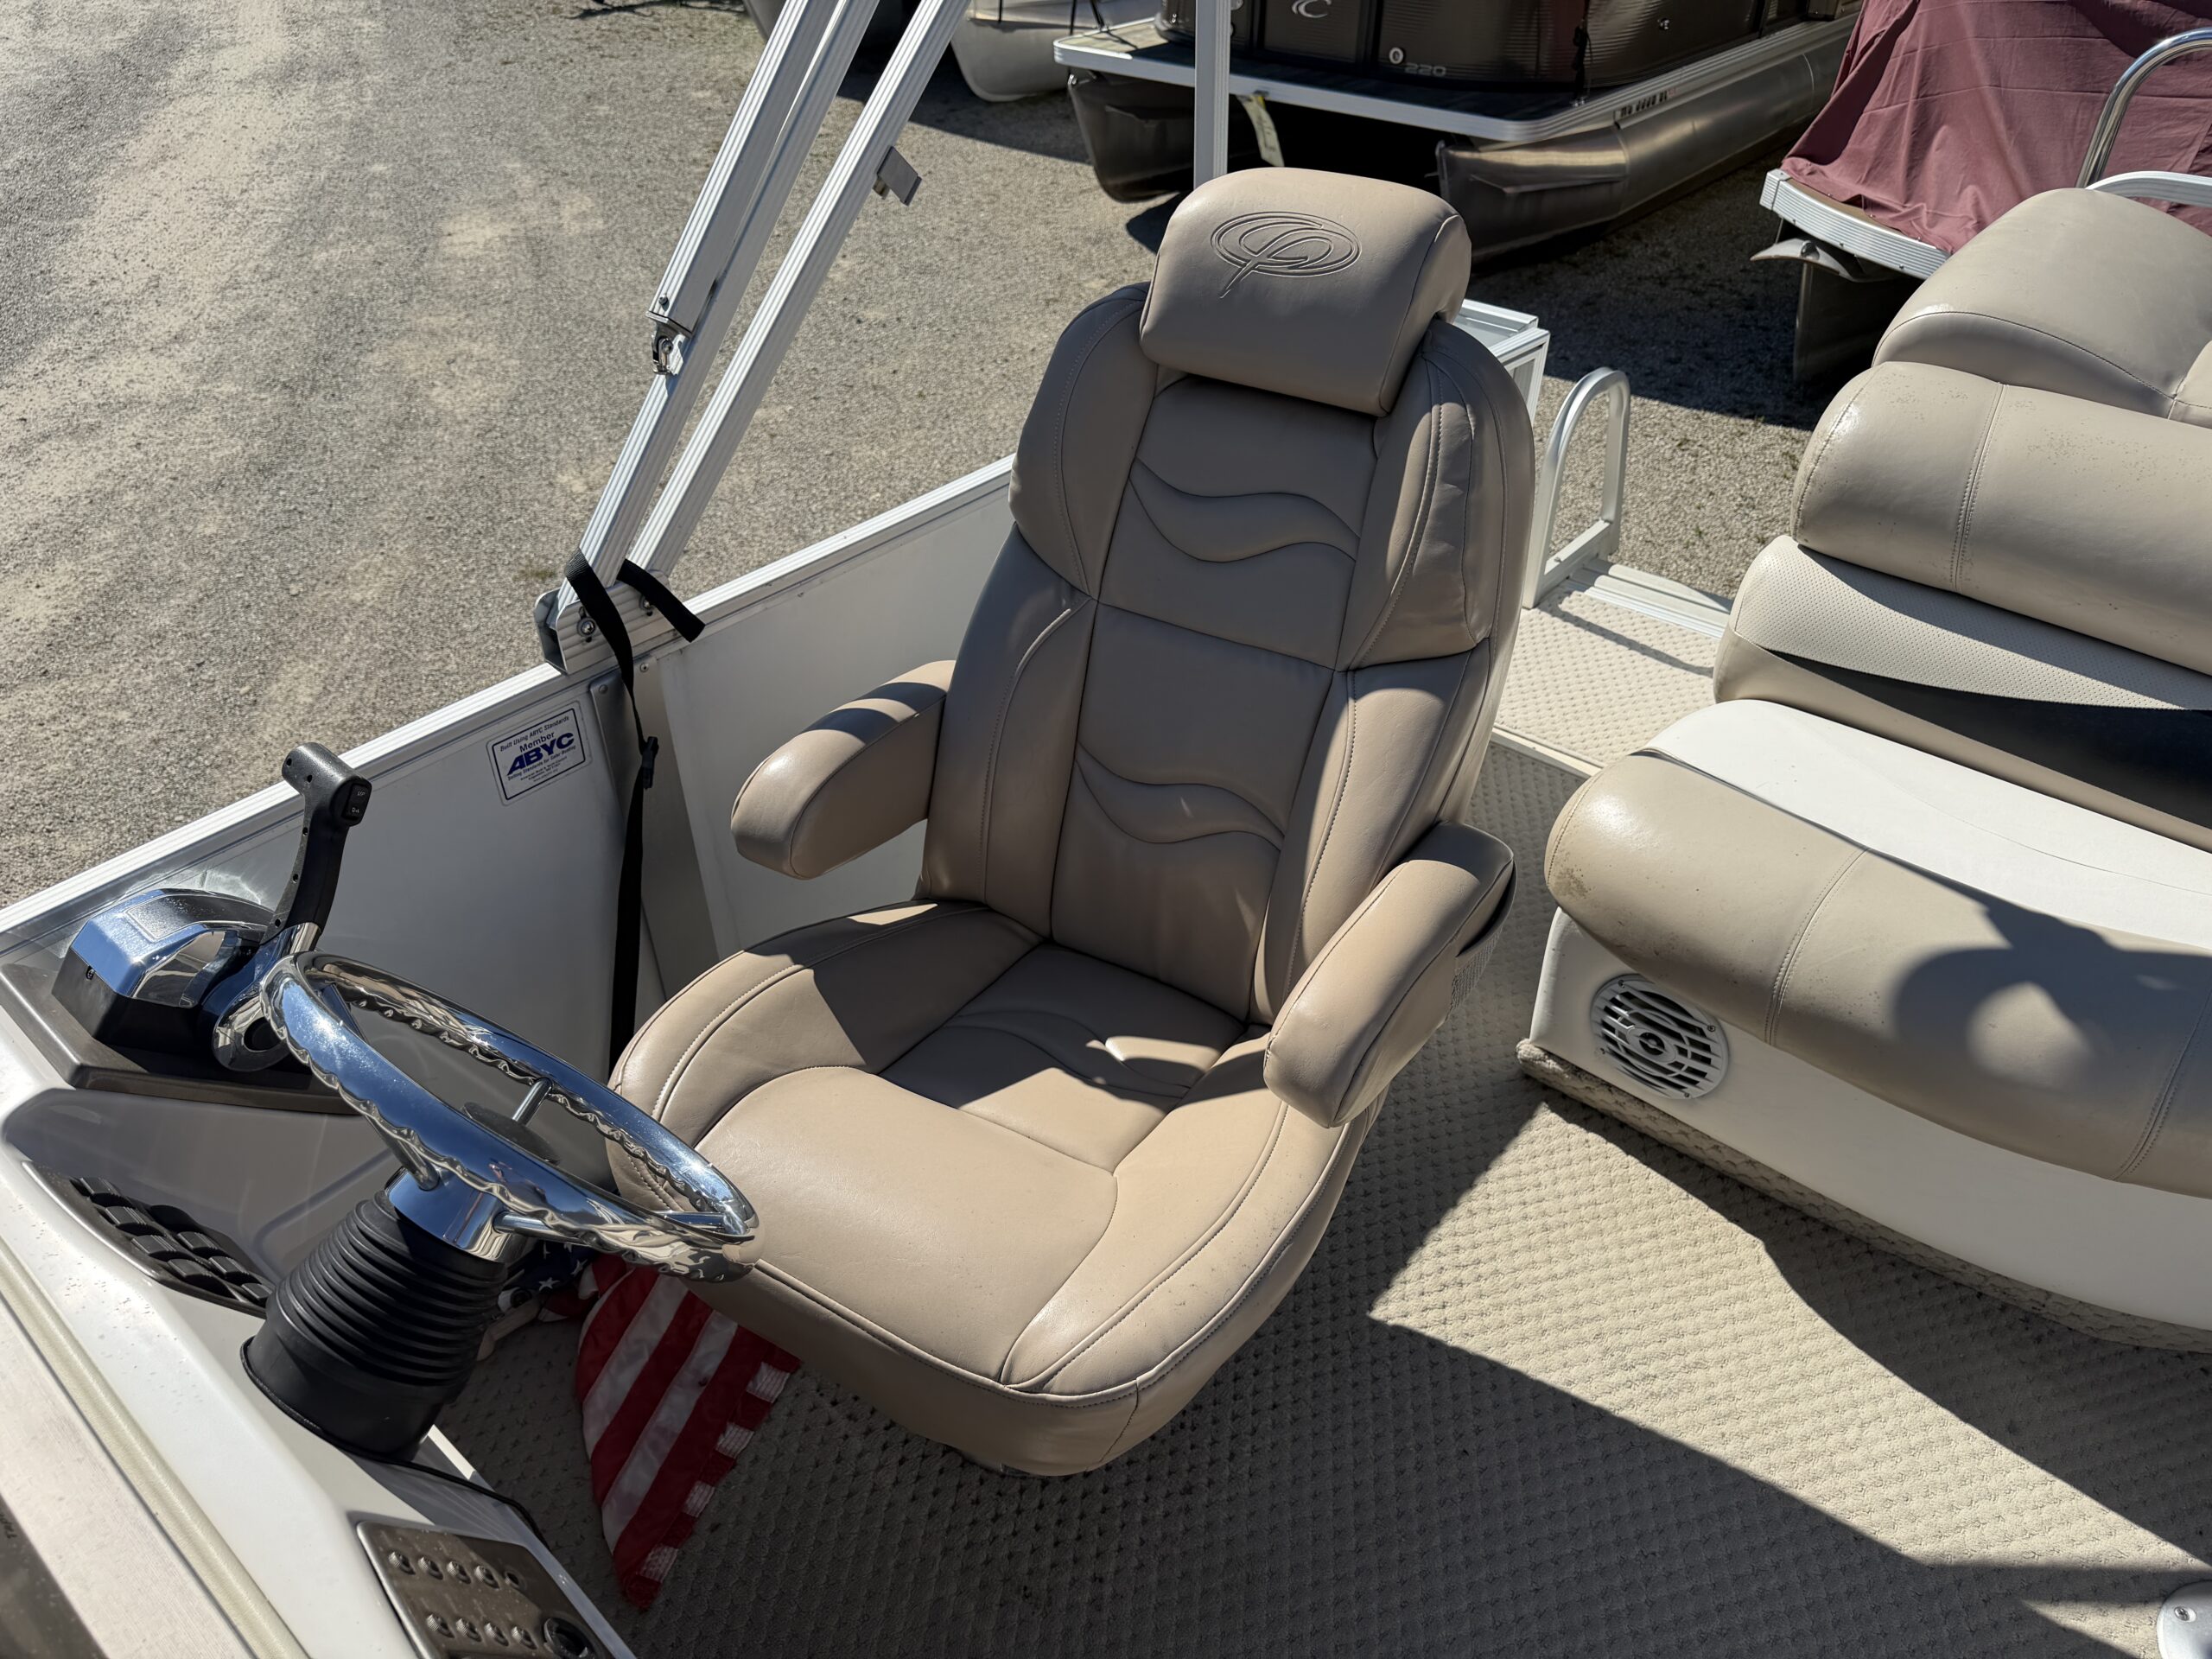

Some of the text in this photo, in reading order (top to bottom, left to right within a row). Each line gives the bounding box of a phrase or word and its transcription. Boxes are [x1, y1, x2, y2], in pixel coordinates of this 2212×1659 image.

[1405, 62, 1446, 77] 220
[513, 734, 529, 746] Using
[544, 715, 569, 731] Standards
[519, 732, 555, 753] Member
[507, 732, 575, 776] ABYC
